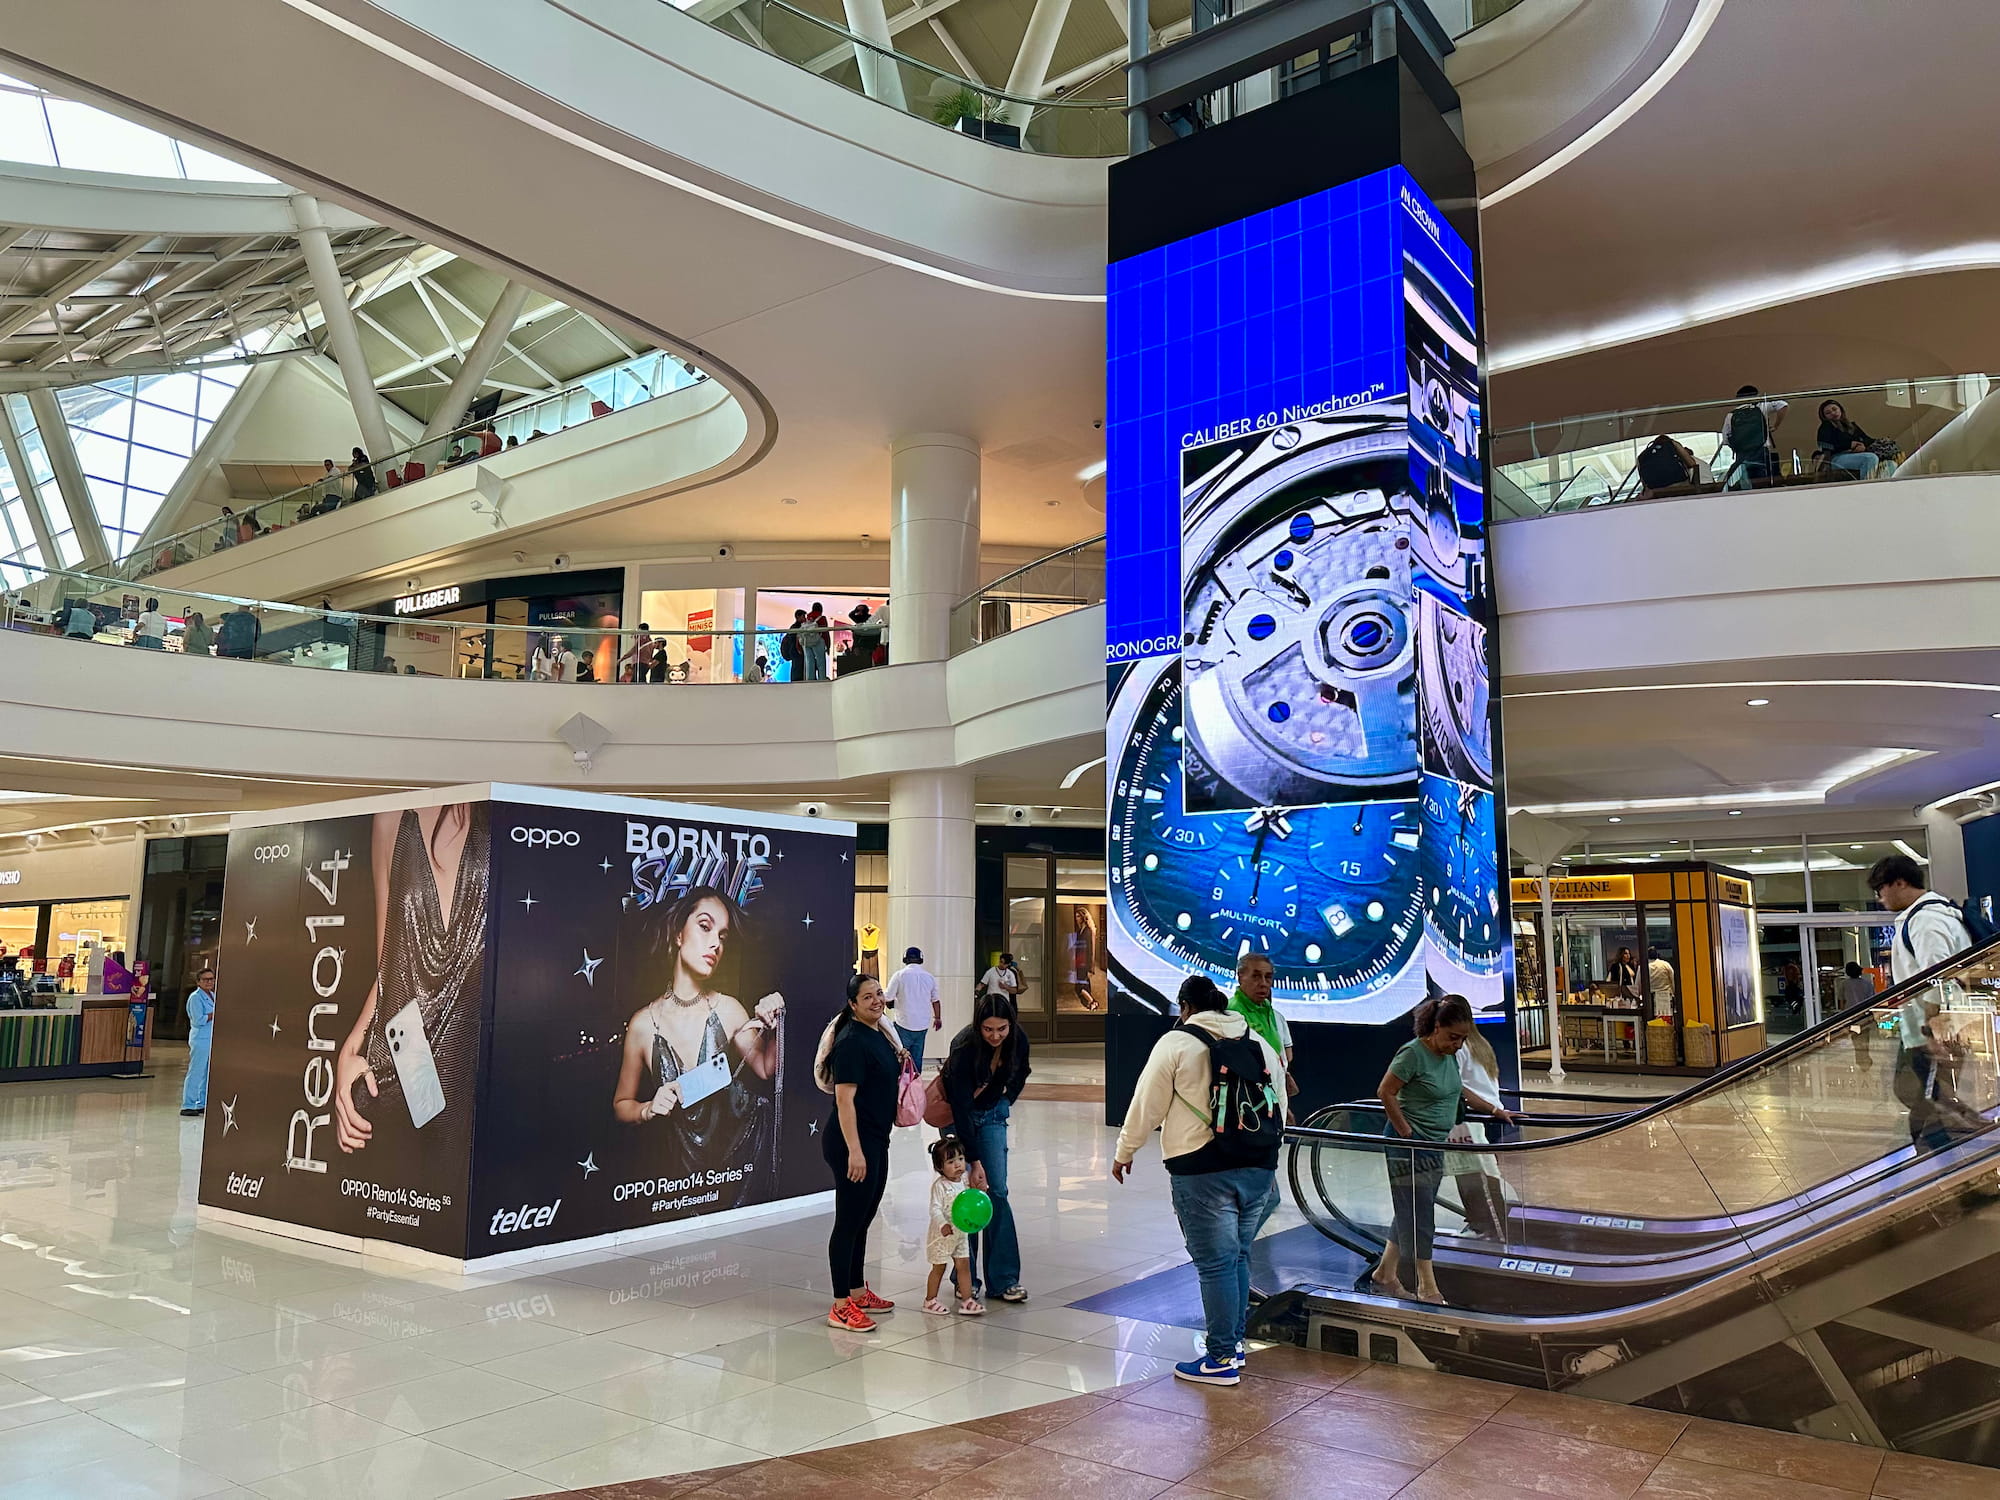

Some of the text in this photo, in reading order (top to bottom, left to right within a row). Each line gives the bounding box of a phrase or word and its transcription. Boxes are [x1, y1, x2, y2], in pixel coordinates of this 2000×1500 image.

[1412, 198, 1440, 241] CROWN
[1181, 418, 1251, 448] CALIBER
[1256, 412, 1278, 429] 60
[395, 586, 460, 615] PULL&BEAR
[1158, 678, 1172, 693] 70
[1131, 732, 1143, 748] 75
[1118, 780, 1128, 797] 80
[1428, 798, 1439, 815] 30
[510, 826, 580, 849] oppo
[626, 821, 771, 860] BORN TO
[1174, 828, 1195, 843] 30
[254, 844, 290, 863] oppo
[1254, 860, 1271, 874] 12
[1339, 860, 1362, 876] 15
[1446, 863, 1453, 878] 9
[0, 870, 20, 885] YSHO
[622, 848, 772, 911] SHINE
[1212, 887, 1223, 901] 9
[1474, 885, 1480, 898] 3
[1220, 908, 1282, 930] MULTIFORT
[1285, 903, 1297, 917] 3
[1135, 932, 1154, 950] 100
[1209, 963, 1236, 979] SWISS
[285, 849, 349, 1174] Reno14
[226, 1171, 264, 1198] telcel
[613, 1179, 655, 1202] OPPO
[657, 1172, 703, 1194] Reno14
[706, 1168, 743, 1186] Series
[340, 1178, 370, 1199] OPPO
[372, 1184, 407, 1205] Reno14
[409, 1191, 441, 1212] Series
[652, 1190, 719, 1212] #PartyEssential
[366, 1206, 420, 1227] #PartyEssential
[489, 1199, 562, 1236] telcel
